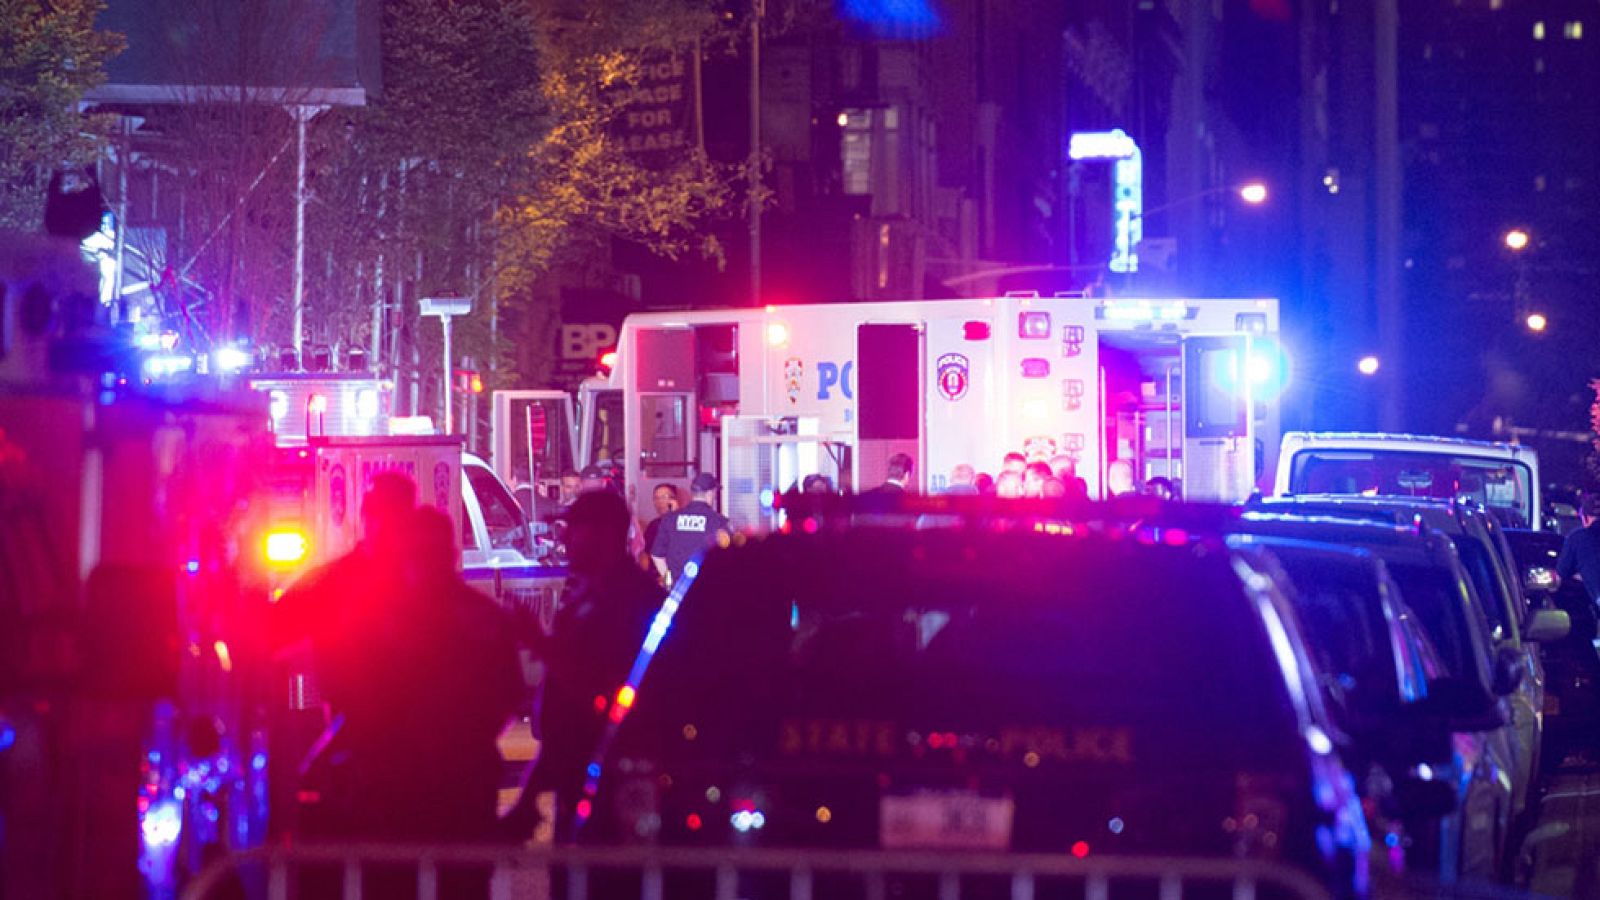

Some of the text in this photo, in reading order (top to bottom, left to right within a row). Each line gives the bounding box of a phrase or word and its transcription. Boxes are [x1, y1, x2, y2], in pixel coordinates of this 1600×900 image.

[627, 109, 672, 127] FOR
[562, 323, 616, 359] BP
[781, 721, 1131, 762] STATE POLICE
